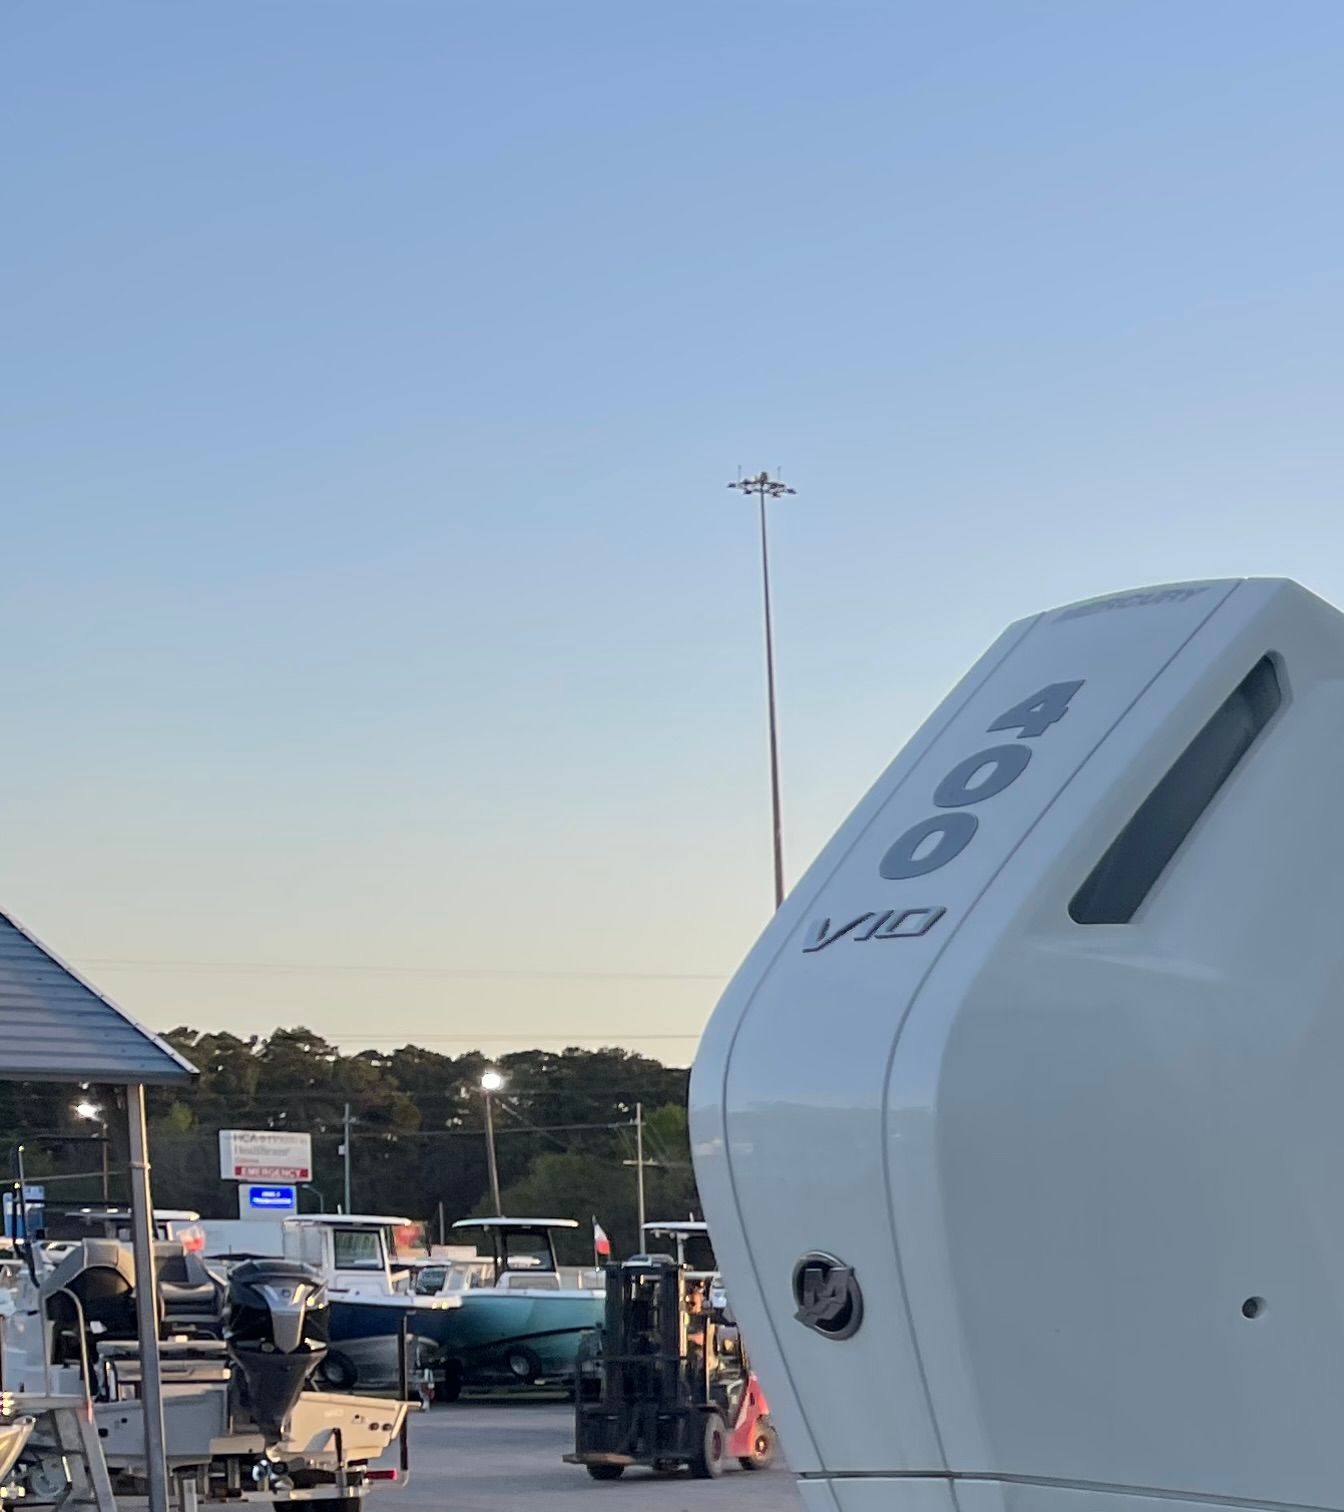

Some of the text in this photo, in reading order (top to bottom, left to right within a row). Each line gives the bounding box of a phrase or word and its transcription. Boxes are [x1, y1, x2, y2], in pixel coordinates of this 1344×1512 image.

[880, 679, 1087, 880] 400
[802, 906, 947, 953] V10
[240, 1167, 301, 1179] EMERGENCY
